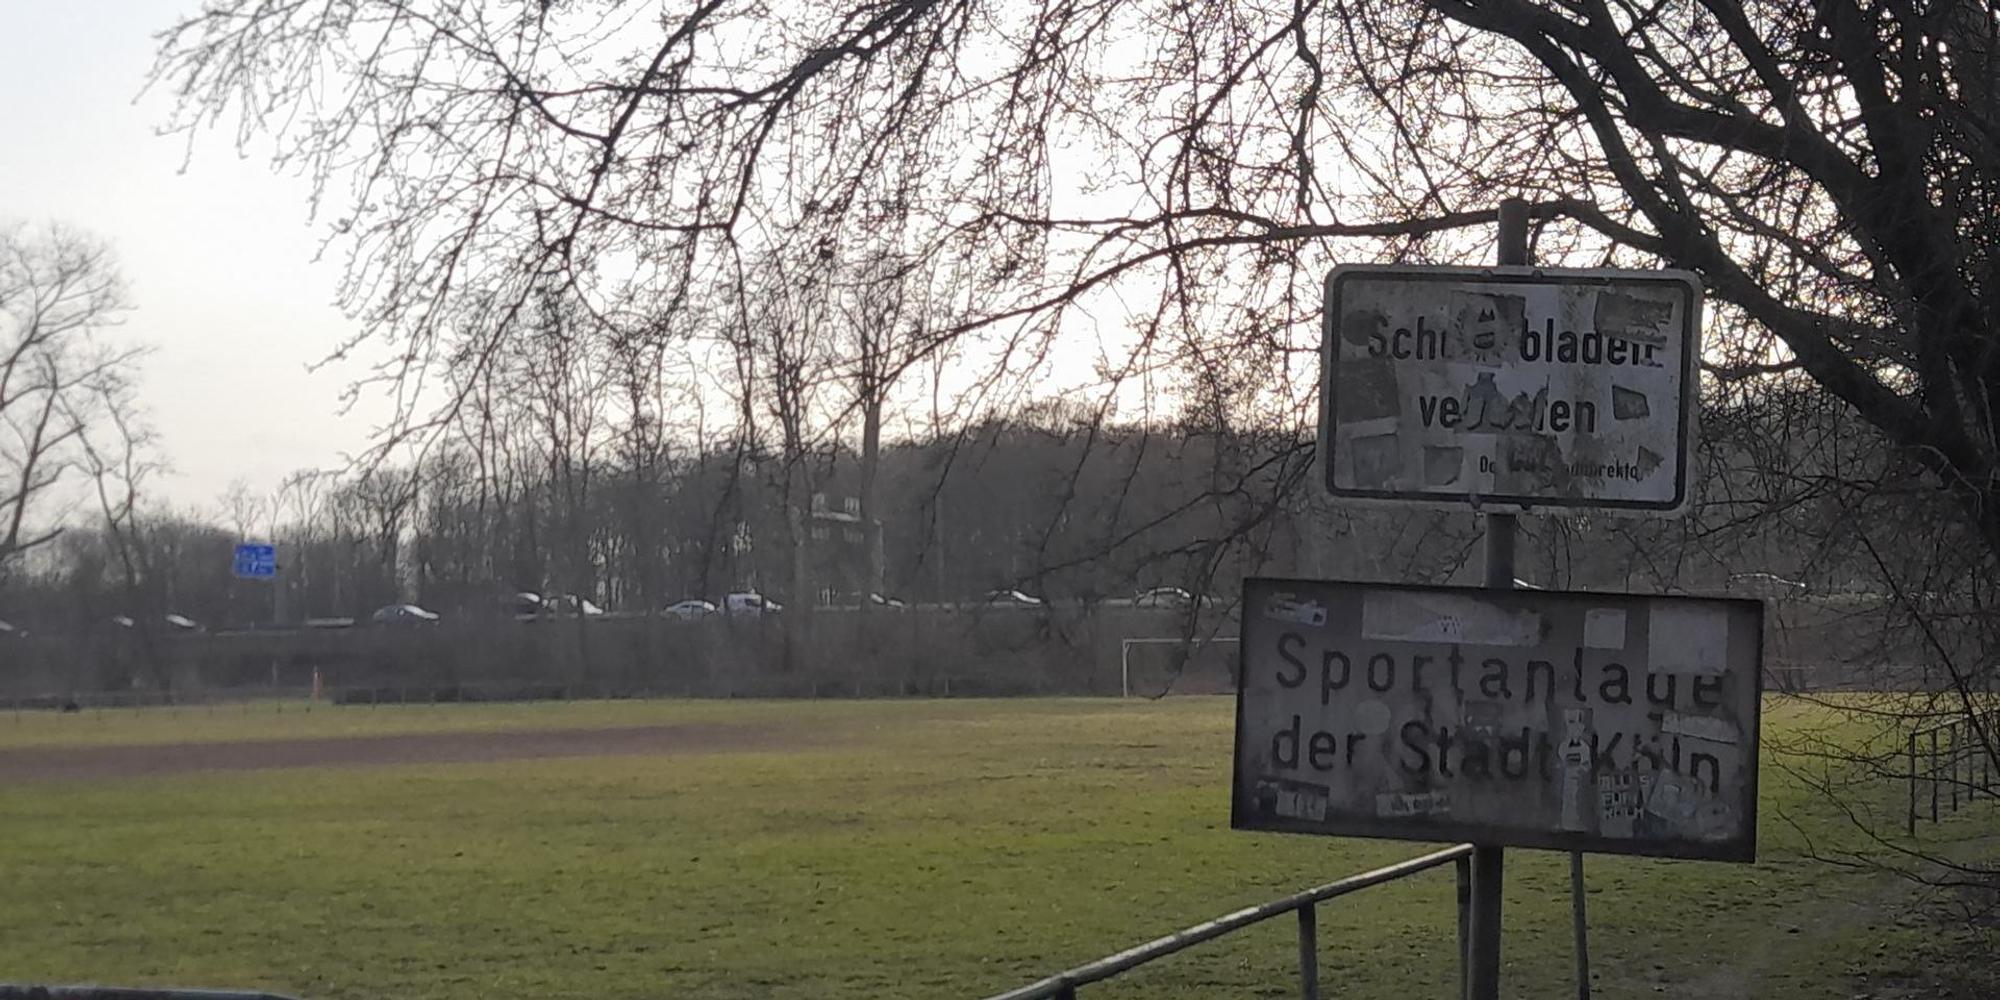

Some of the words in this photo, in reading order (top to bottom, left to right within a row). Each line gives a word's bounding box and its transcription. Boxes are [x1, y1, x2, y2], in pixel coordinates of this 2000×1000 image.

[1275, 631, 1724, 722] Sportanlage
[1271, 714, 1366, 772] der
[1399, 719, 1553, 783] Stadt
